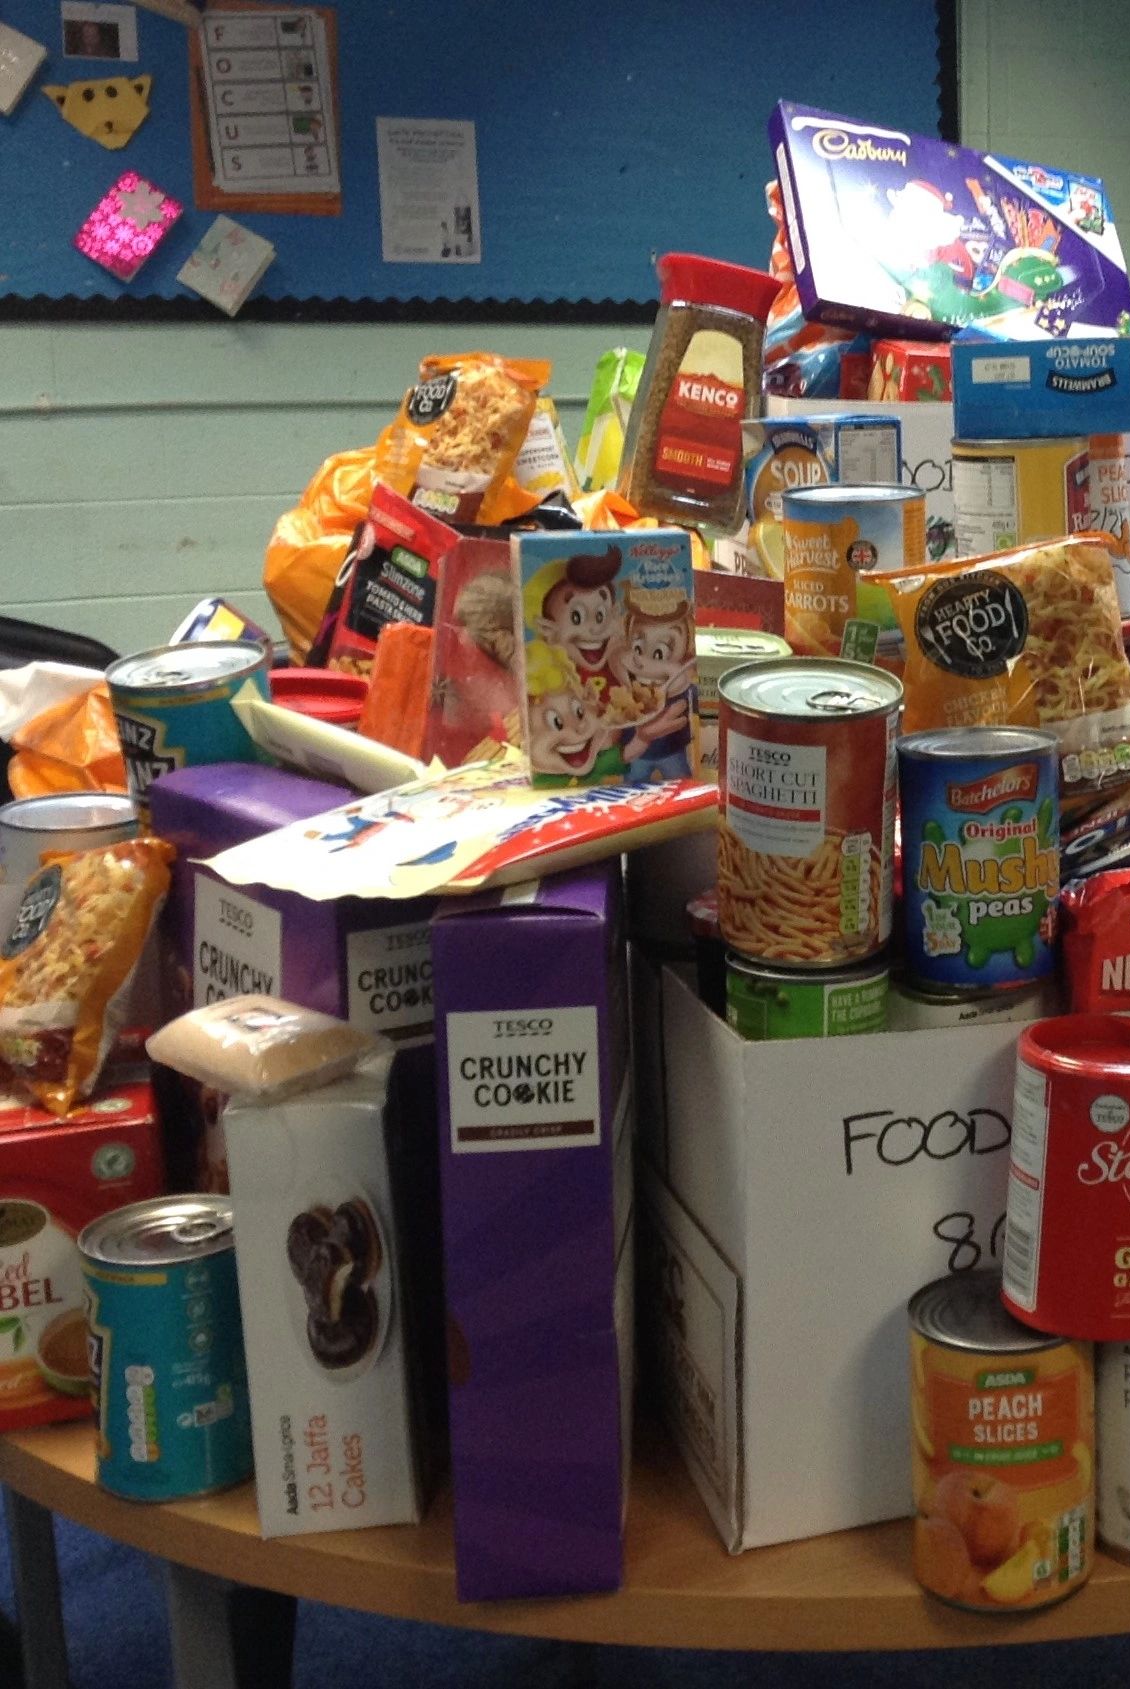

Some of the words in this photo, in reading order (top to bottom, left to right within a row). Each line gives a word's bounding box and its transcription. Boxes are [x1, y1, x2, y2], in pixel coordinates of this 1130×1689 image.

[216, 59, 231, 74] O
[225, 124, 239, 140] U
[812, 129, 907, 167] Cadbury
[1055, 355, 1108, 369] TOMATO
[678, 380, 739, 410] KENCO
[1052, 373, 1112, 391] BRAMWELLS
[662, 446, 704, 468] SMOOTH
[770, 459, 823, 489] SOUP
[934, 589, 990, 621] HEARTY
[936, 603, 1006, 646] FOOD
[749, 746, 791, 762] TESCO
[729, 758, 775, 785] SHORT
[780, 772, 819, 789] CUT
[728, 777, 819, 805] SPAGHETTI
[952, 773, 1033, 807] Batchelors
[965, 818, 1037, 841] Original
[918, 837, 1060, 897] Mushy
[219, 898, 254, 925] TESCO
[969, 896, 1034, 925] peas
[199, 939, 274, 994] CRUNCHY
[357, 960, 433, 993] CRUNC
[369, 986, 433, 1015] COOK
[493, 1018, 554, 1033] TESCO
[460, 1052, 587, 1081] CRUNCHY
[474, 1080, 575, 1108] COOKIE
[842, 1107, 1012, 1176] FOOD
[0, 1277, 63, 1312] BEL
[967, 1391, 1044, 1420] PEACH
[304, 1413, 331, 1475] Jaffa
[973, 1421, 1039, 1443] SLICES
[339, 1432, 366, 1509] Cakes
[284, 1483, 298, 1516] Asda
[308, 1482, 335, 1513] 12
